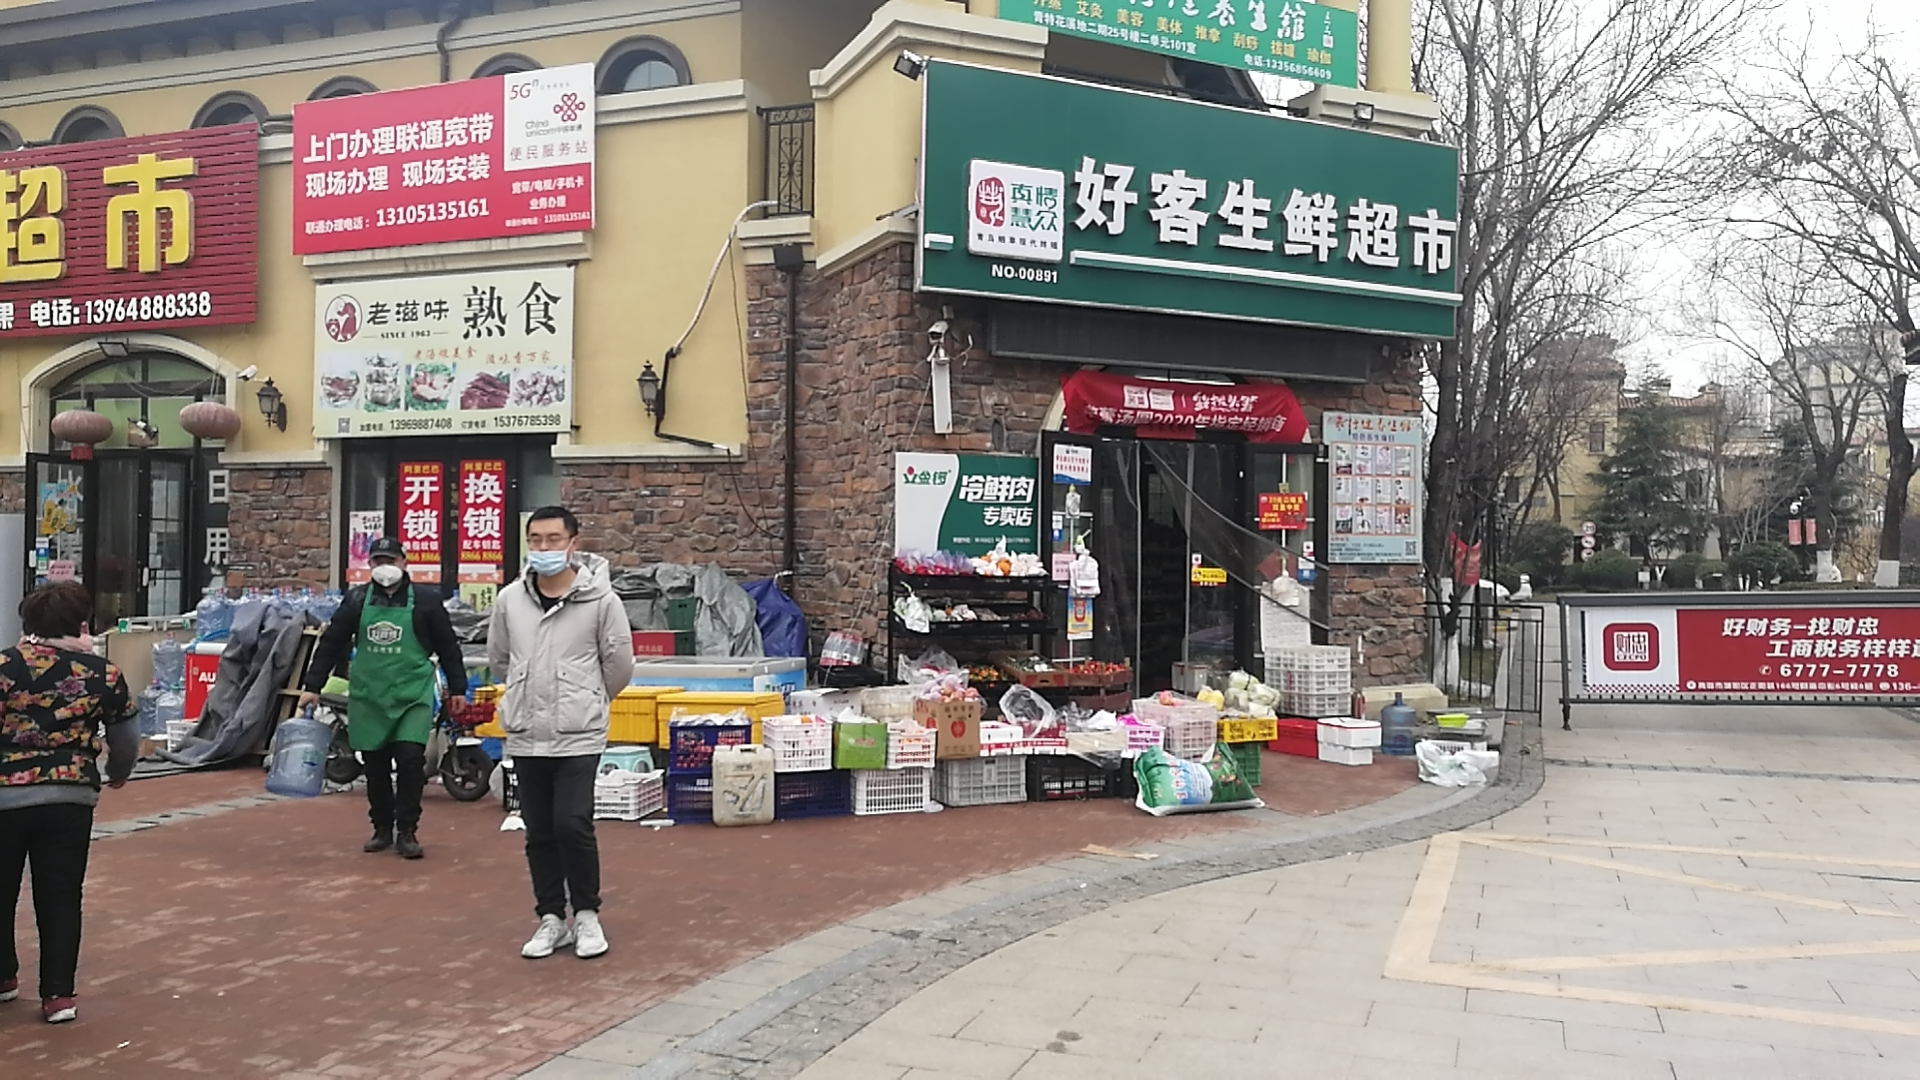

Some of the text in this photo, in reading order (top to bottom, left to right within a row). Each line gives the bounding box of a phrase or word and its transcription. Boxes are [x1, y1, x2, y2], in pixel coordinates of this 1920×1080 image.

[1076, 0, 1103, 19] 艾灸
[1117, 8, 1144, 27] 美容
[1157, 16, 1183, 35] 美体
[1195, 24, 1221, 43] 推拿
[1307, 47, 1332, 65] 瑜伽
[302, 112, 494, 163] 上门办理联通宽带
[510, 140, 588, 161] 便民服务站
[305, 153, 490, 198] 现场办理 现场安装
[376, 198, 489, 227] 13105135161
[529, 195, 566, 210] 业务办理
[1073, 155, 1458, 274] 好客生鲜超市
[0, 153, 197, 283] 超市
[992, 264, 1058, 283] NO.00891
[30, 291, 211, 327] 电话:13964888338
[367, 281, 562, 340] 老滋味 熟食
[380, 331, 407, 339] SINCE
[494, 414, 561, 428] 15376785398
[404, 465, 439, 474] 阿里巴巴
[464, 462, 503, 471] 阿里巴巴
[959, 475, 1035, 503] 冷鲜肉
[403, 476, 439, 540] 开锁
[463, 472, 503, 539] 换锁
[983, 507, 1034, 527] 专卖店
[1779, 663, 1900, 678] 6777-7778
